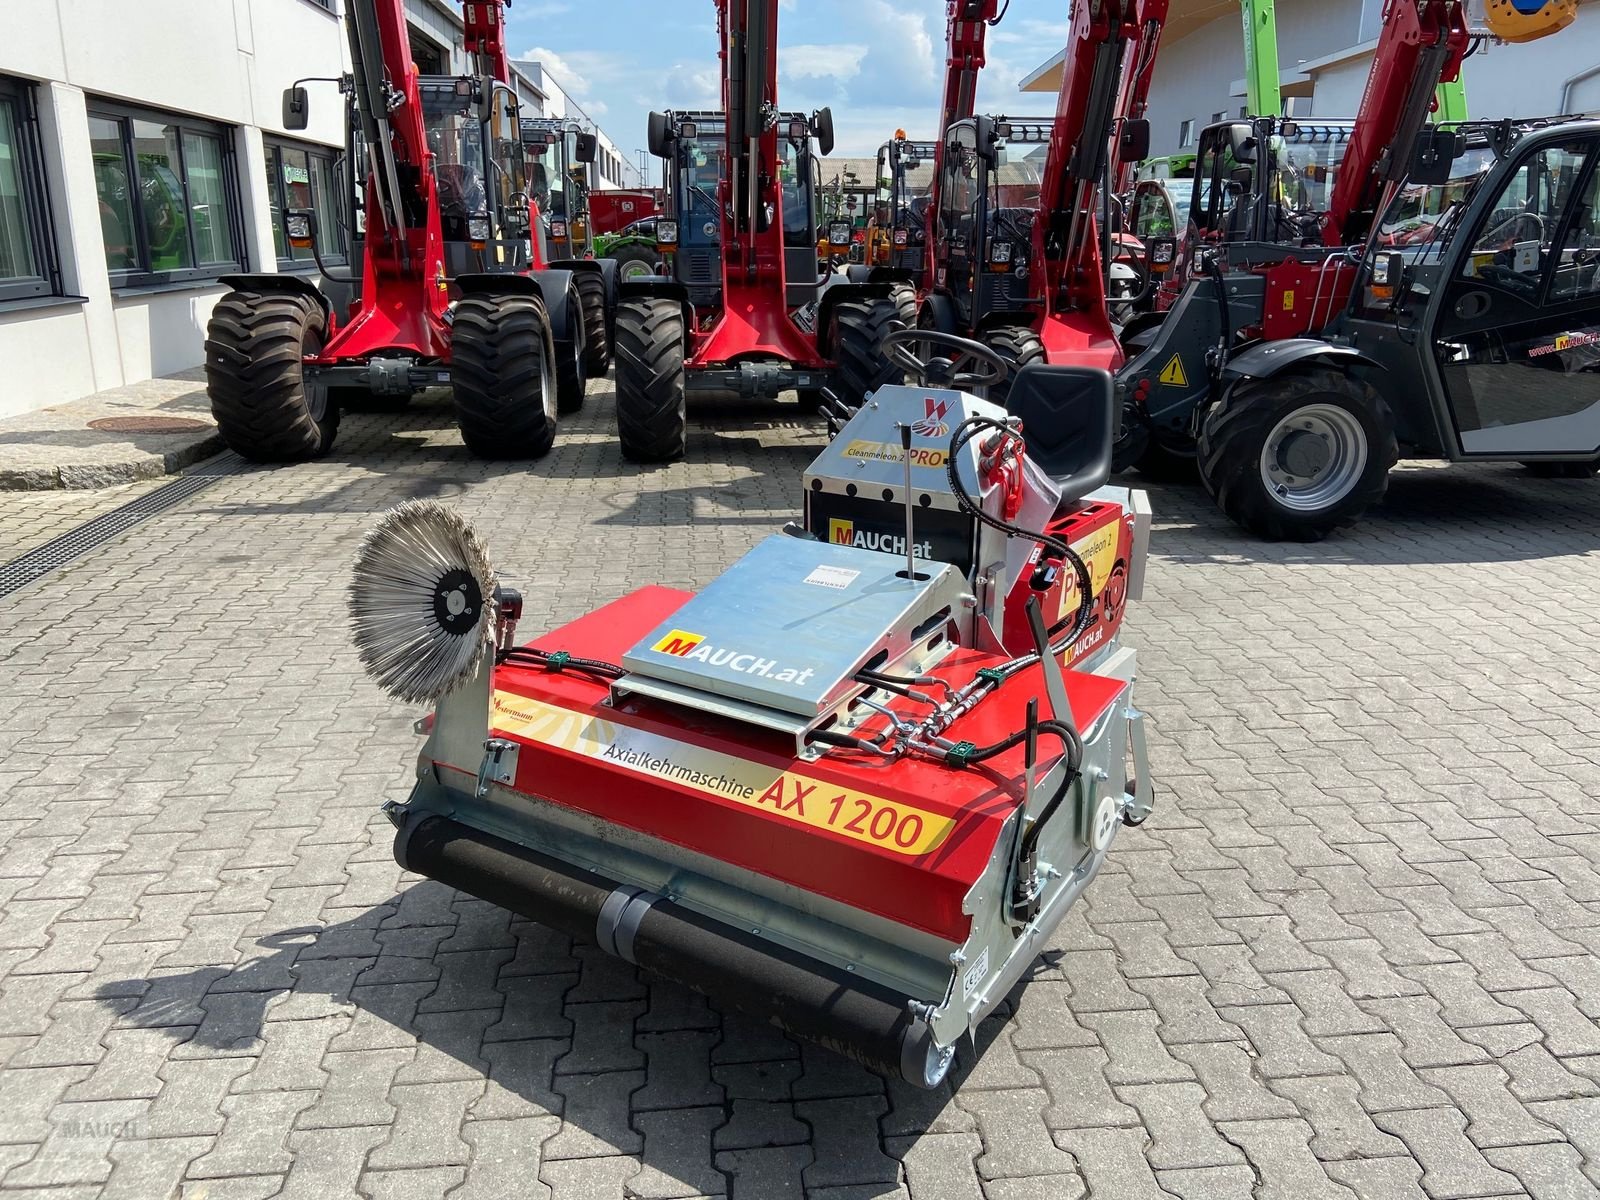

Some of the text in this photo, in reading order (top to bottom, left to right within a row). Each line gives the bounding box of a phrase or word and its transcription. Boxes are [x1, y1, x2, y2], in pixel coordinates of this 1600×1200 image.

[847, 448, 898, 463] Cleanmeleon
[910, 448, 942, 467] PRO
[834, 526, 932, 560] MAUCH.at
[661, 638, 816, 686] MAUCH.at
[602, 743, 924, 848] Axialkehrmaschine AX 1200
